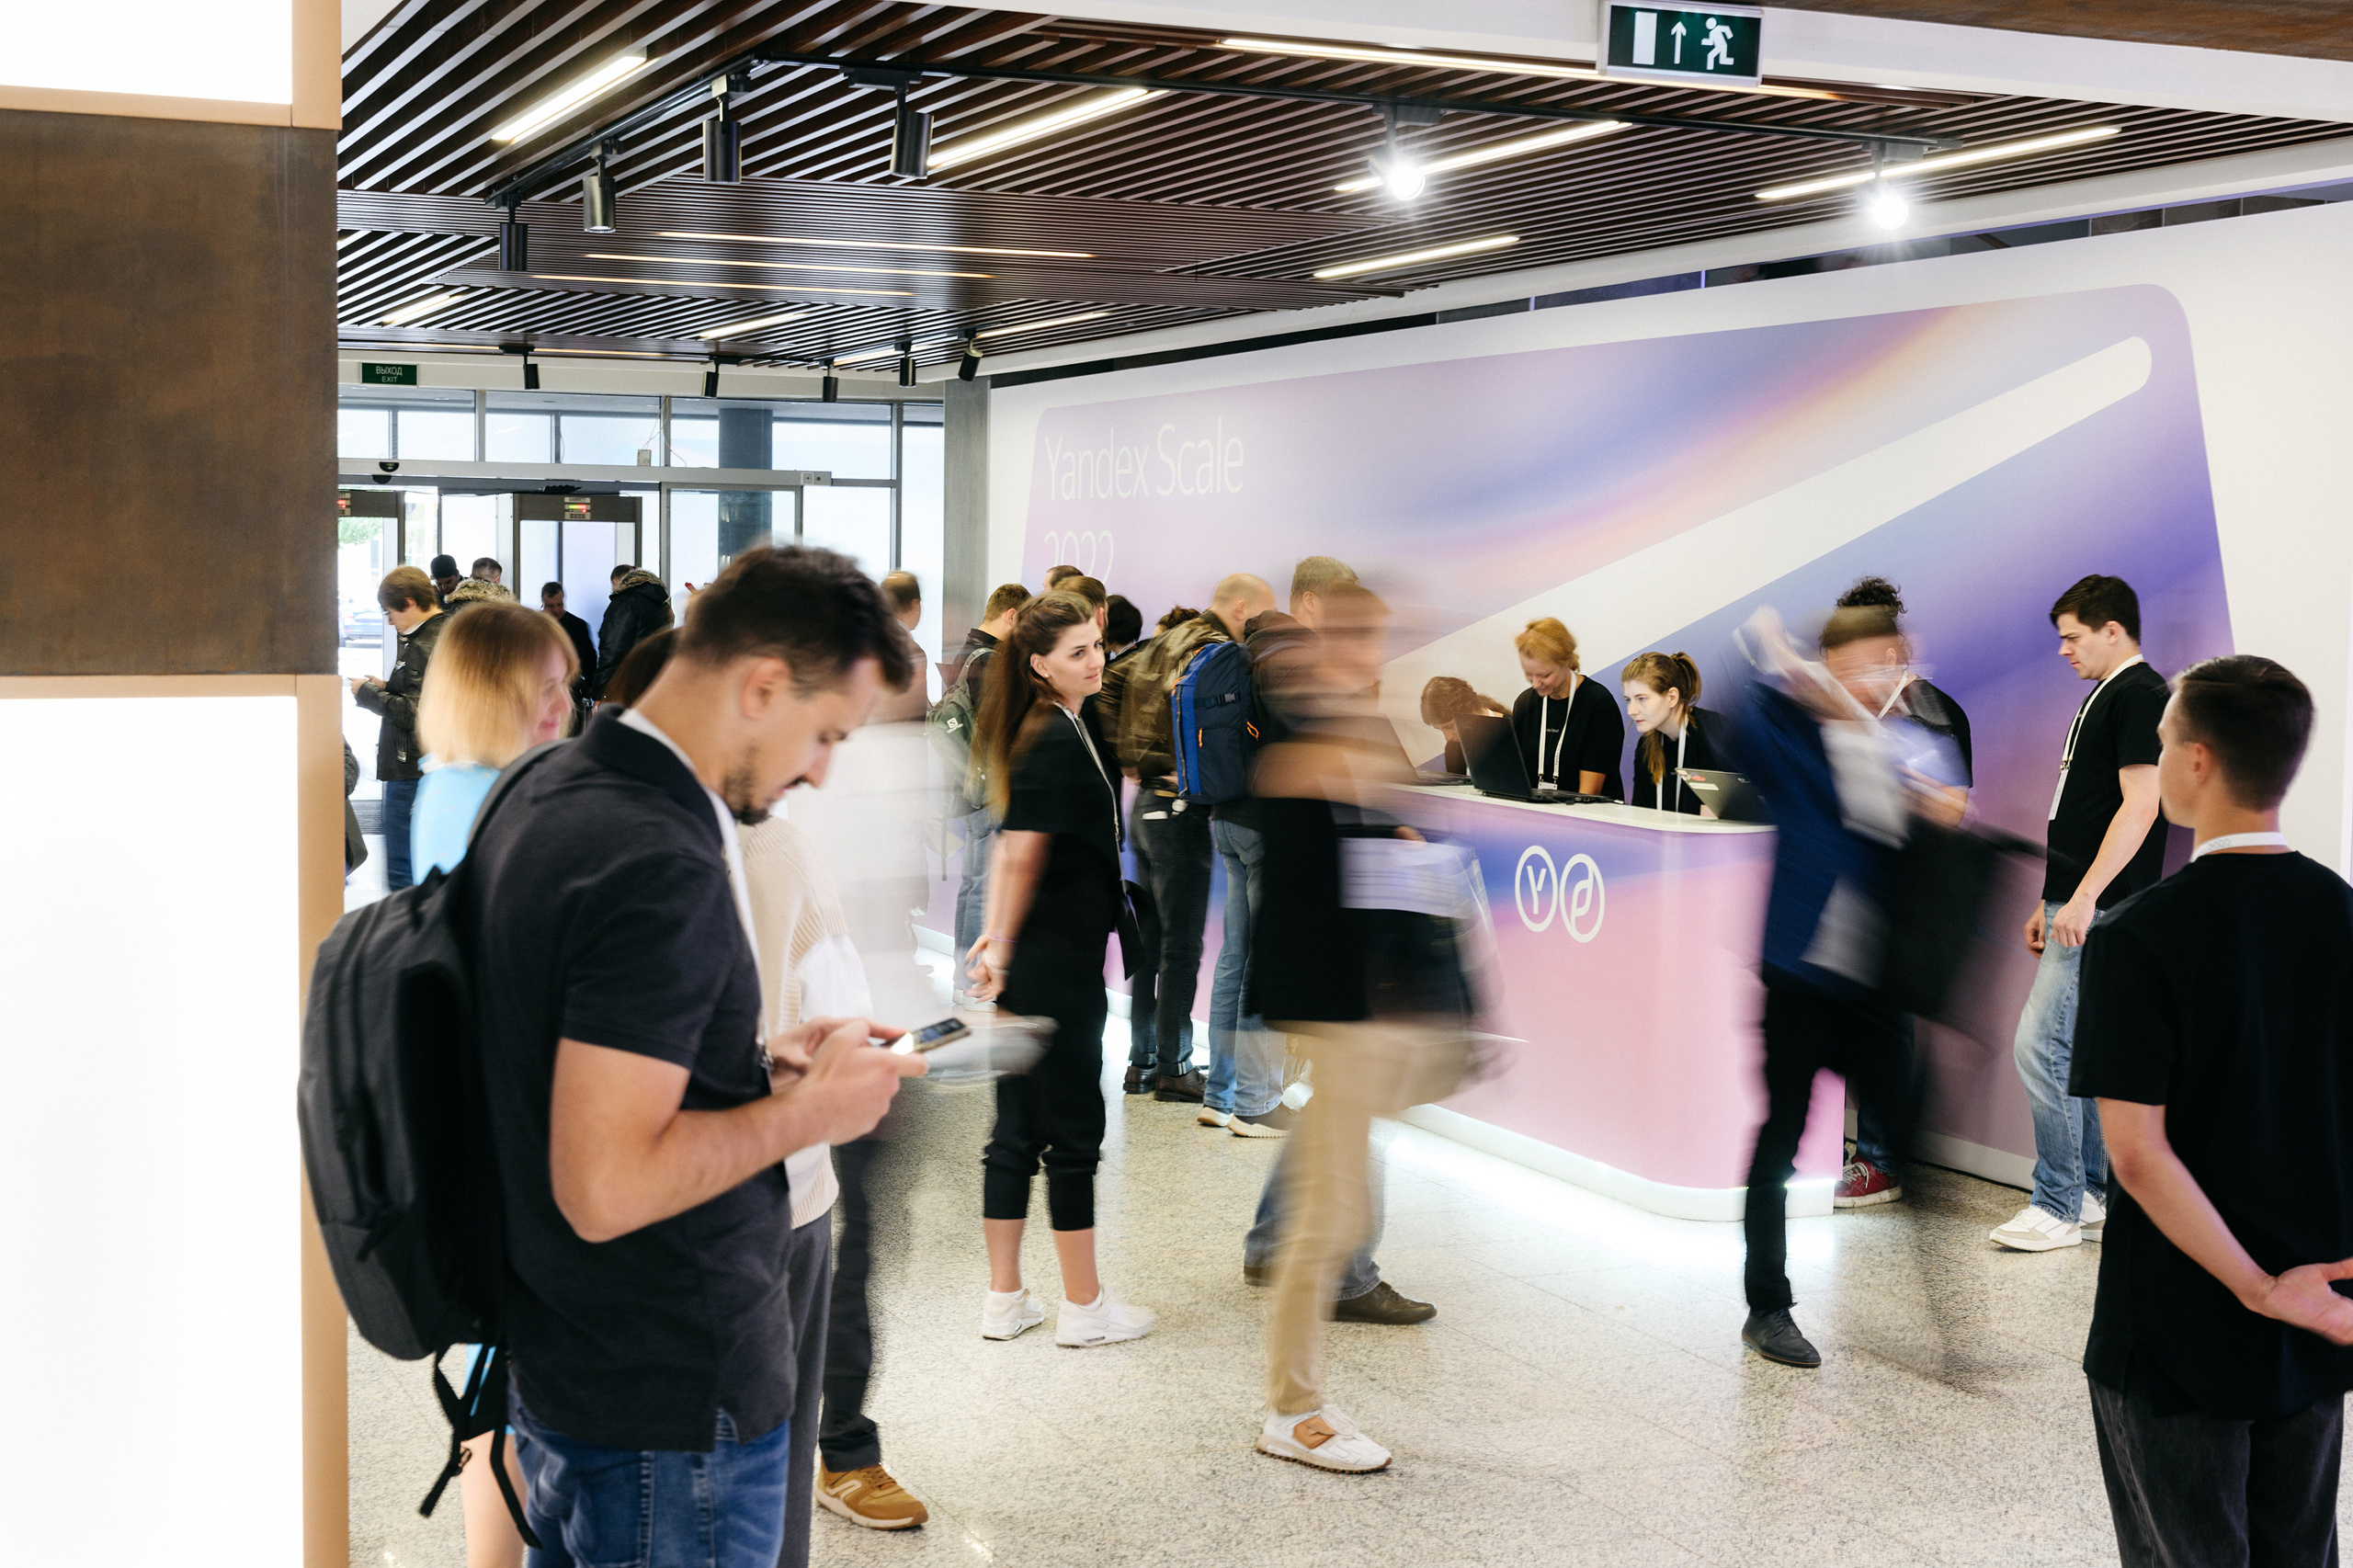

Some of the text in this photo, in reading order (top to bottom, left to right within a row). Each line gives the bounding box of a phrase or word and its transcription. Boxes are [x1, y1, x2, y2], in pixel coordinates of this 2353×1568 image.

[375, 366, 403, 376] ВЫХОД
[1044, 415, 1244, 500] Yandex Scale
